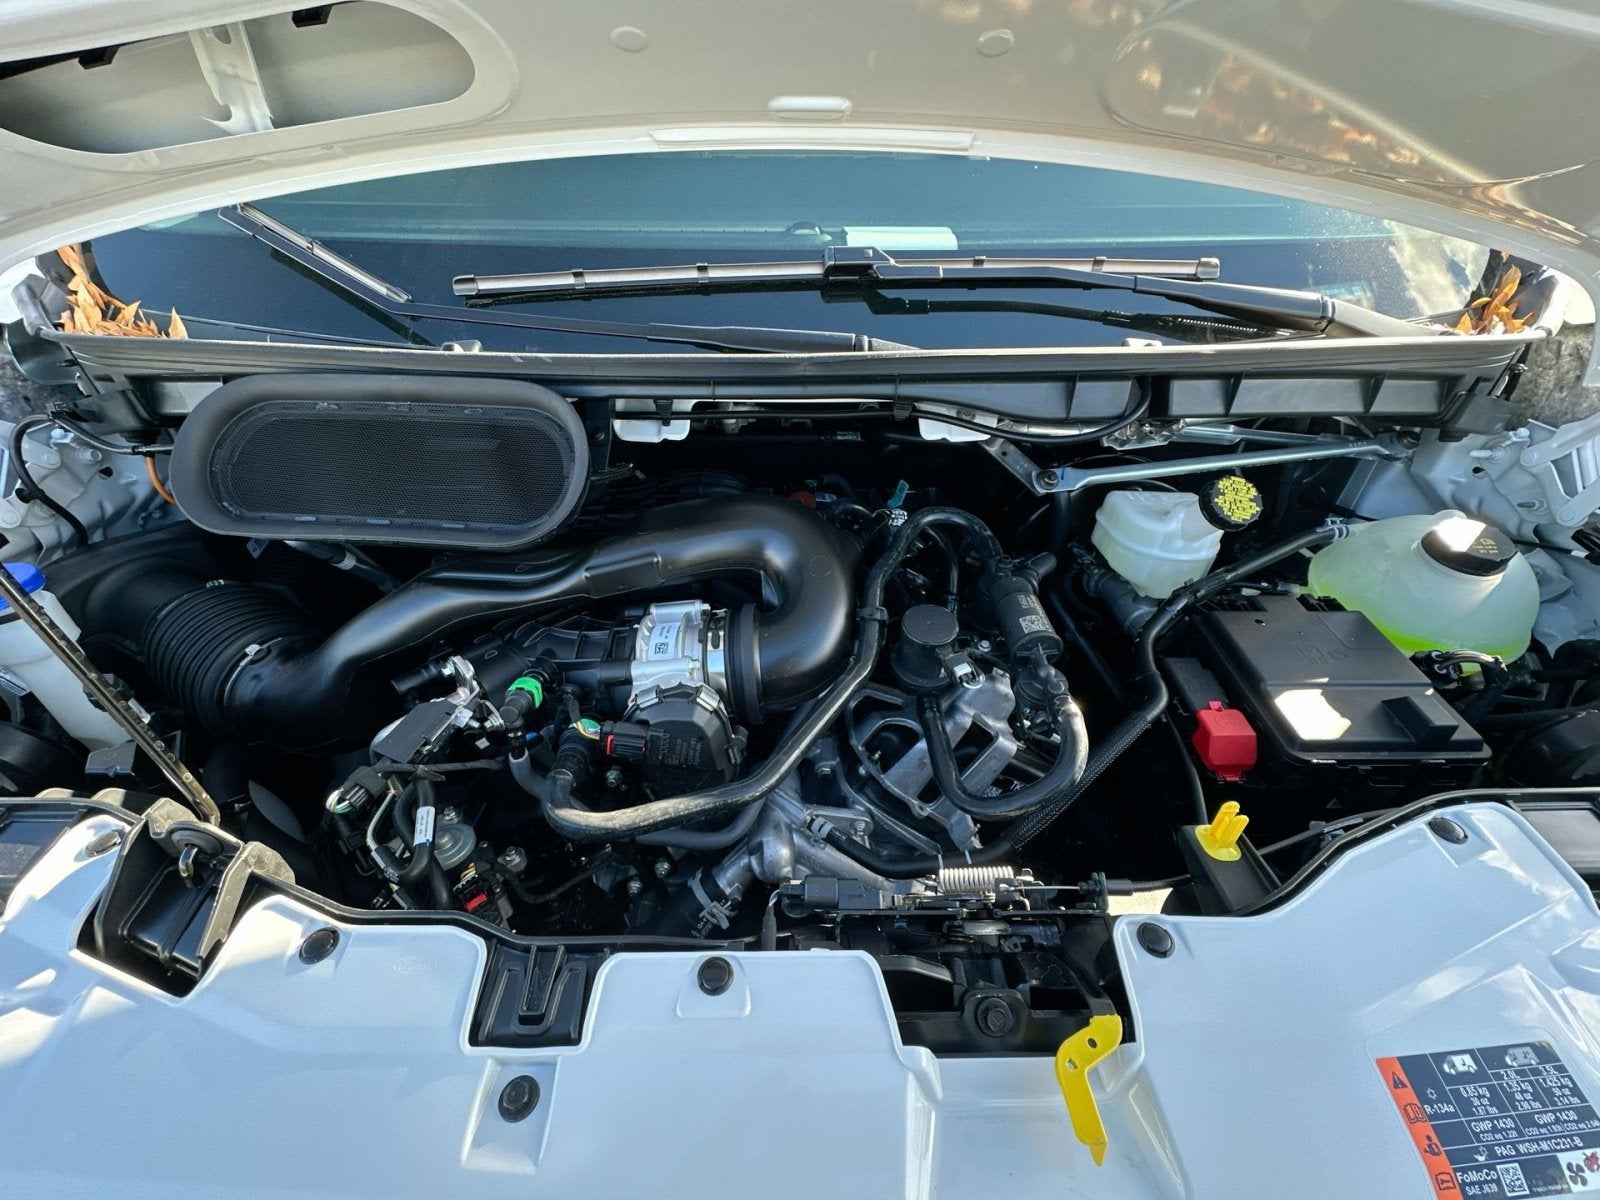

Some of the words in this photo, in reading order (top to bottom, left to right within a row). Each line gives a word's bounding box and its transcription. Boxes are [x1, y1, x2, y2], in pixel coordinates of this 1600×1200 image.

[1501, 1070, 1520, 1080] 2.0L
[1539, 1065, 1559, 1075] 3.5L
[1504, 1080, 1521, 1092] 1.35
[1519, 1080, 1533, 1092] kg
[1540, 1077, 1561, 1088] 1.425
[1559, 1076, 1573, 1088] kg
[1460, 1086, 1478, 1097] 0.85
[1476, 1085, 1490, 1097] kg
[1524, 1092, 1533, 1100] oz
[1529, 1100, 1543, 1109] lbs
[1568, 1095, 1581, 1104] lbs
[1424, 1102, 1455, 1115] R-134a
[1486, 1105, 1498, 1114] lbs
[1534, 1113, 1556, 1124] GWP
[1556, 1110, 1578, 1121] 1430
[1471, 1121, 1493, 1132] GWP
[1494, 1118, 1515, 1129] 1430
[1564, 1122, 1578, 1131] CO2
[1578, 1123, 1587, 1131] eq
[1480, 1133, 1494, 1141] CO2
[1494, 1133, 1505, 1142] eq
[1525, 1127, 1539, 1136] CO2
[1539, 1127, 1550, 1137] eq
[1494, 1145, 1516, 1157] PAG
[1516, 1137, 1583, 1154] WSH-M1C231-B
[1456, 1169, 1498, 1184] FoMoCo
[1466, 1184, 1482, 1195] SAE
[1482, 1183, 1498, 1194] J639
